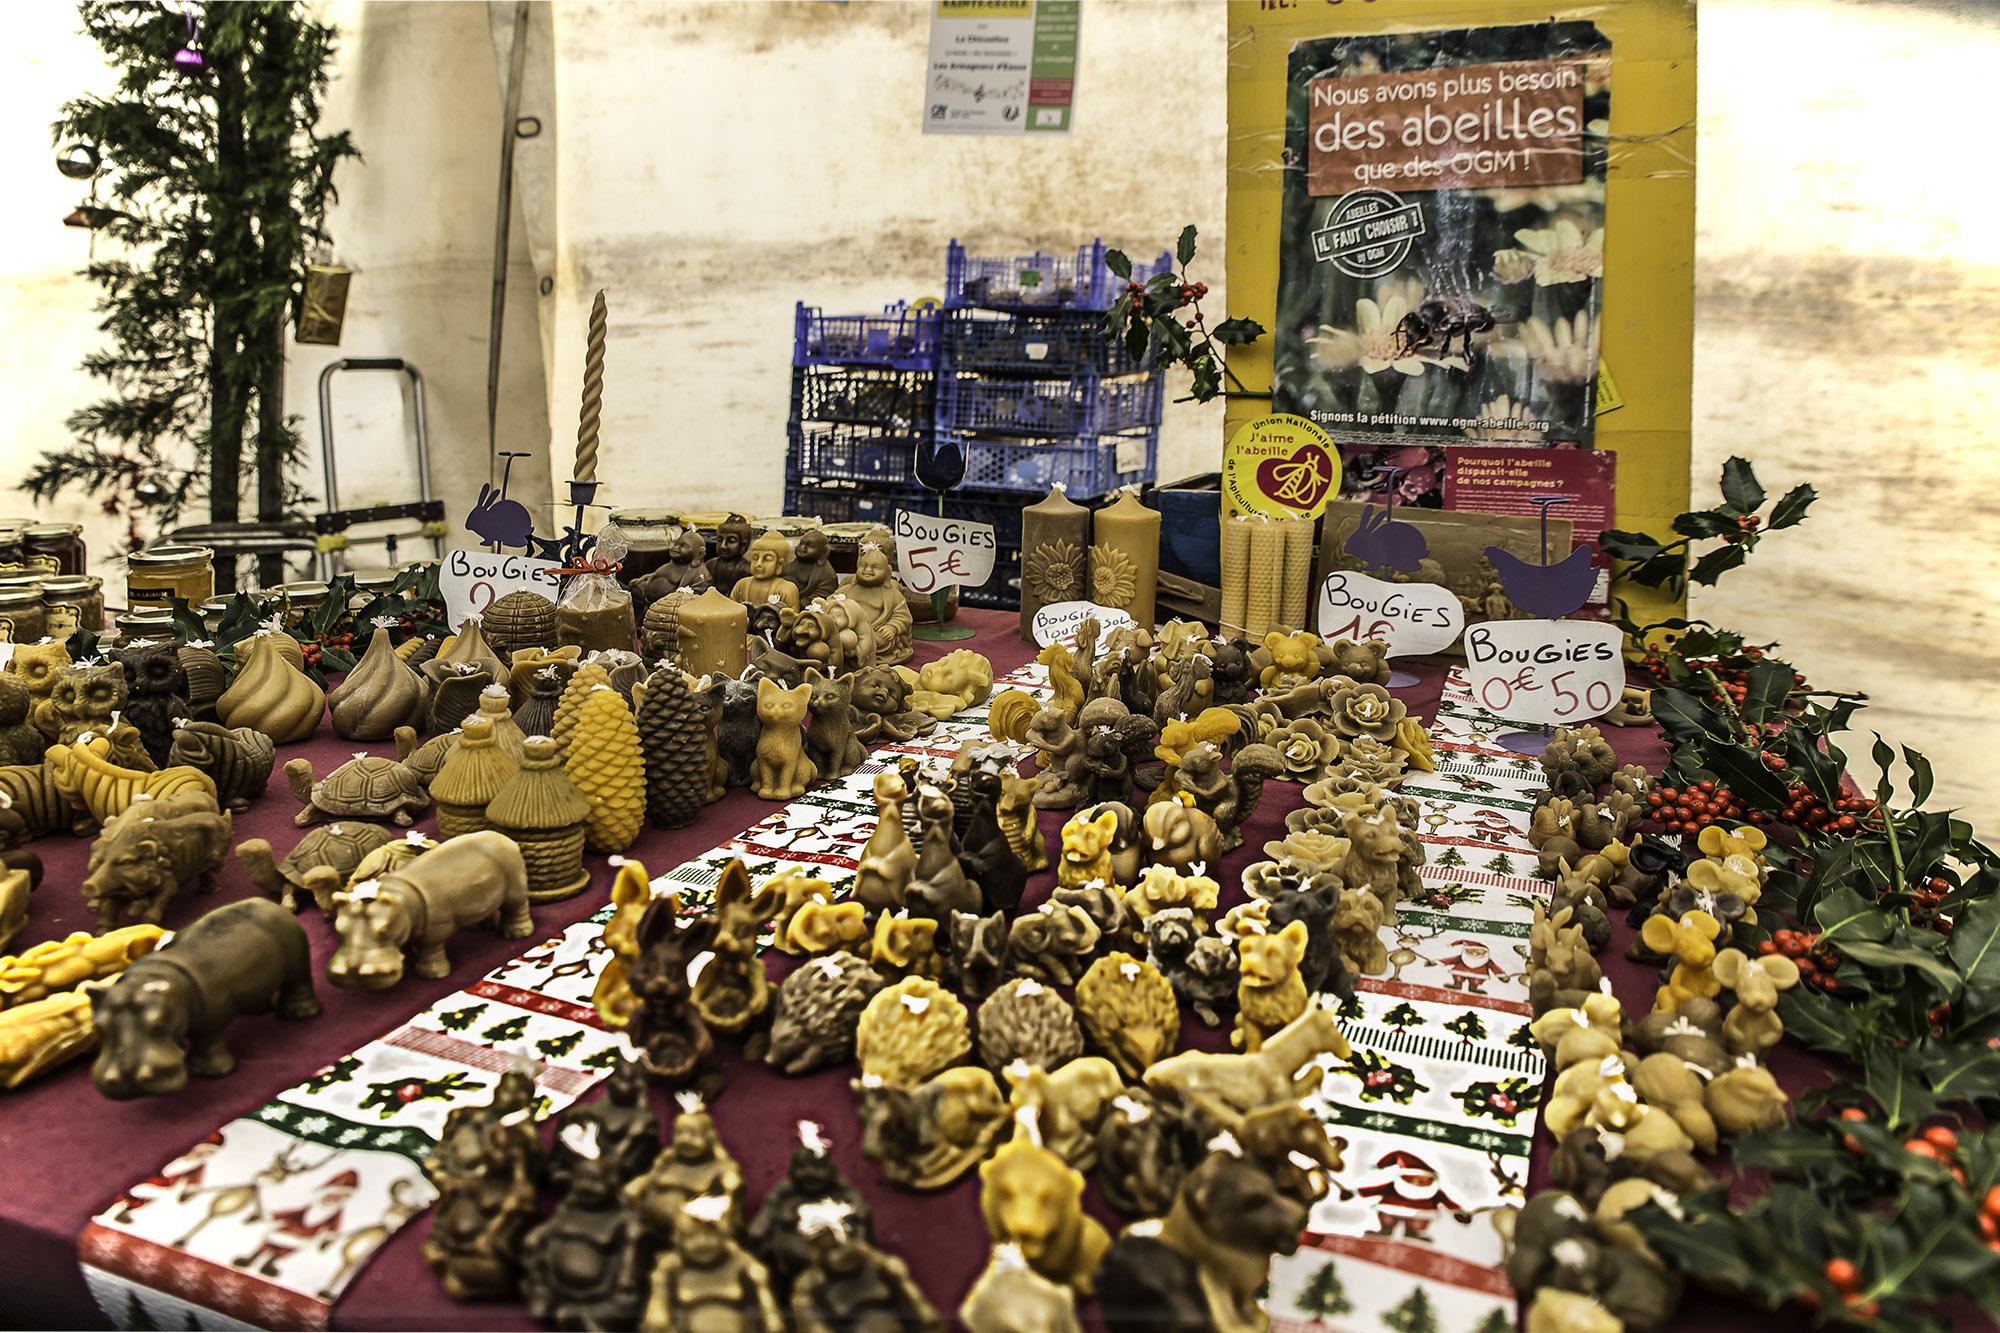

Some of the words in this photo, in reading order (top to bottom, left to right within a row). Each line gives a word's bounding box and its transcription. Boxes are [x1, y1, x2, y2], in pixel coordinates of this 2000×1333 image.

[1314, 84, 1369, 108] Nous
[1375, 81, 1438, 103] avons
[1443, 72, 1493, 103] plus
[1499, 67, 1577, 93] besoin
[1314, 111, 1386, 153] des
[1401, 96, 1577, 148] abeilles
[1354, 161, 1396, 185] que
[1403, 155, 1443, 178] des
[1451, 149, 1516, 175] OGM
[1346, 201, 1380, 221] ABEILLES
[1317, 235, 1331, 253] IL
[1332, 226, 1361, 249] FAUT
[1364, 214, 1409, 240] CHOISIR
[1310, 409, 1355, 424] Signons
[1357, 412, 1369, 423] la
[1370, 412, 1417, 426] pétition
[1420, 416, 1550, 433] www.ogm-abeille.org
[1250, 433, 1295, 443] J'aime
[1252, 417, 1283, 430] Union
[1286, 417, 1330, 449] Nationale
[1237, 445, 1289, 456] l'abeille
[1228, 459, 1236, 471] de
[1457, 457, 1505, 467] Pourquoi
[1507, 458, 1553, 468] l'abeille
[1456, 477, 1470, 485] de
[1472, 478, 1491, 486] nos
[1493, 479, 1556, 489] campagnes
